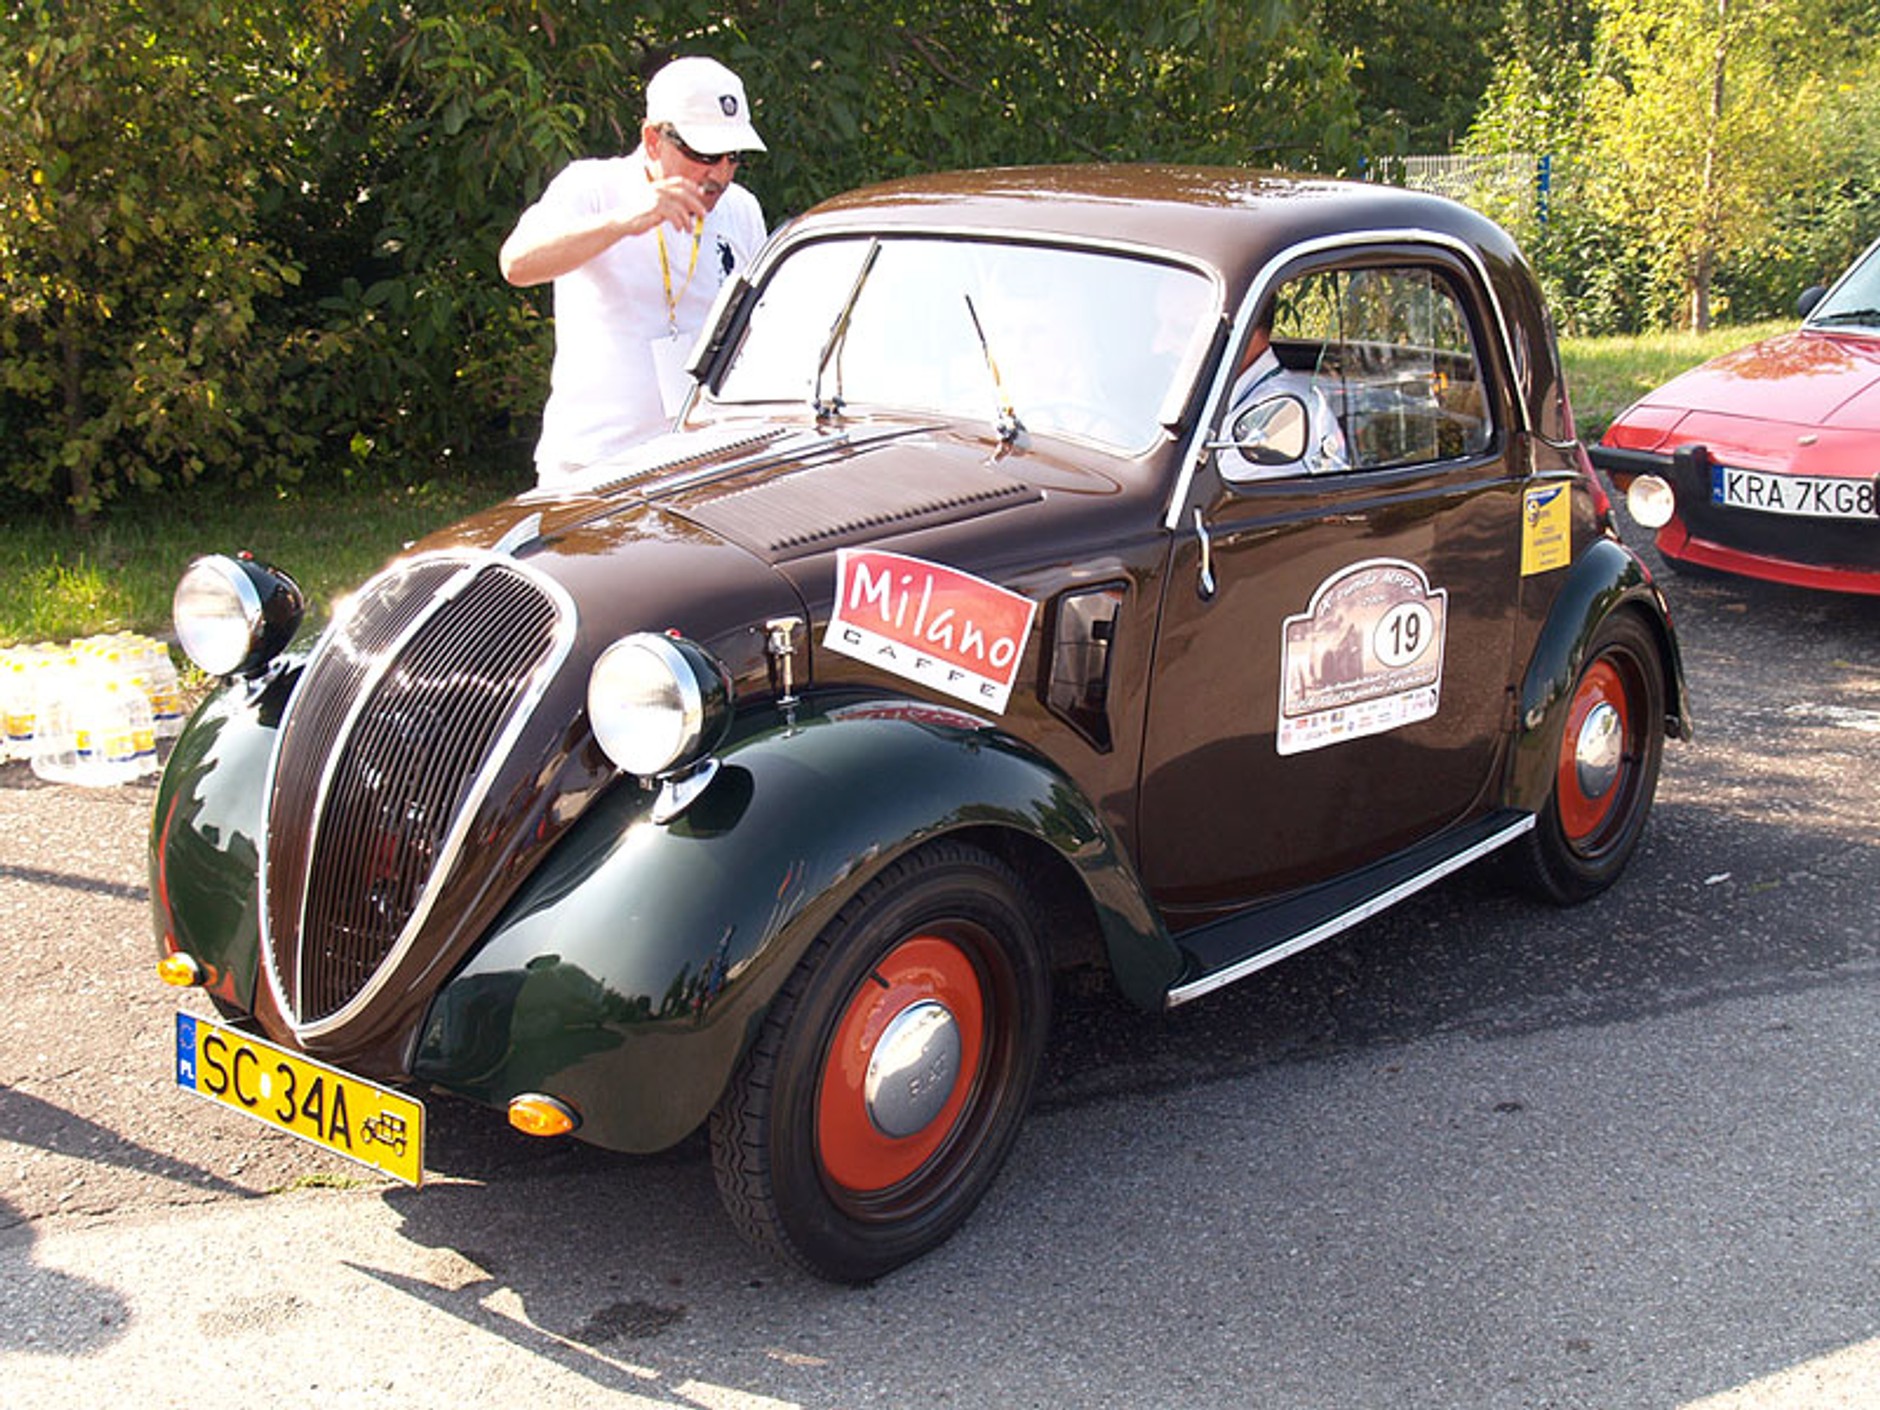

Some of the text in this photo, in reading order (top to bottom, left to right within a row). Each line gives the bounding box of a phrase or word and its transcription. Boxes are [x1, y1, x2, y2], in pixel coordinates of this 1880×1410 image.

[1727, 471, 1874, 514] KRA 7KG8
[849, 561, 1016, 669] Milano
[1390, 612, 1421, 656] 19
[842, 627, 997, 698] CAFFE
[203, 1034, 353, 1150] SC 34A
